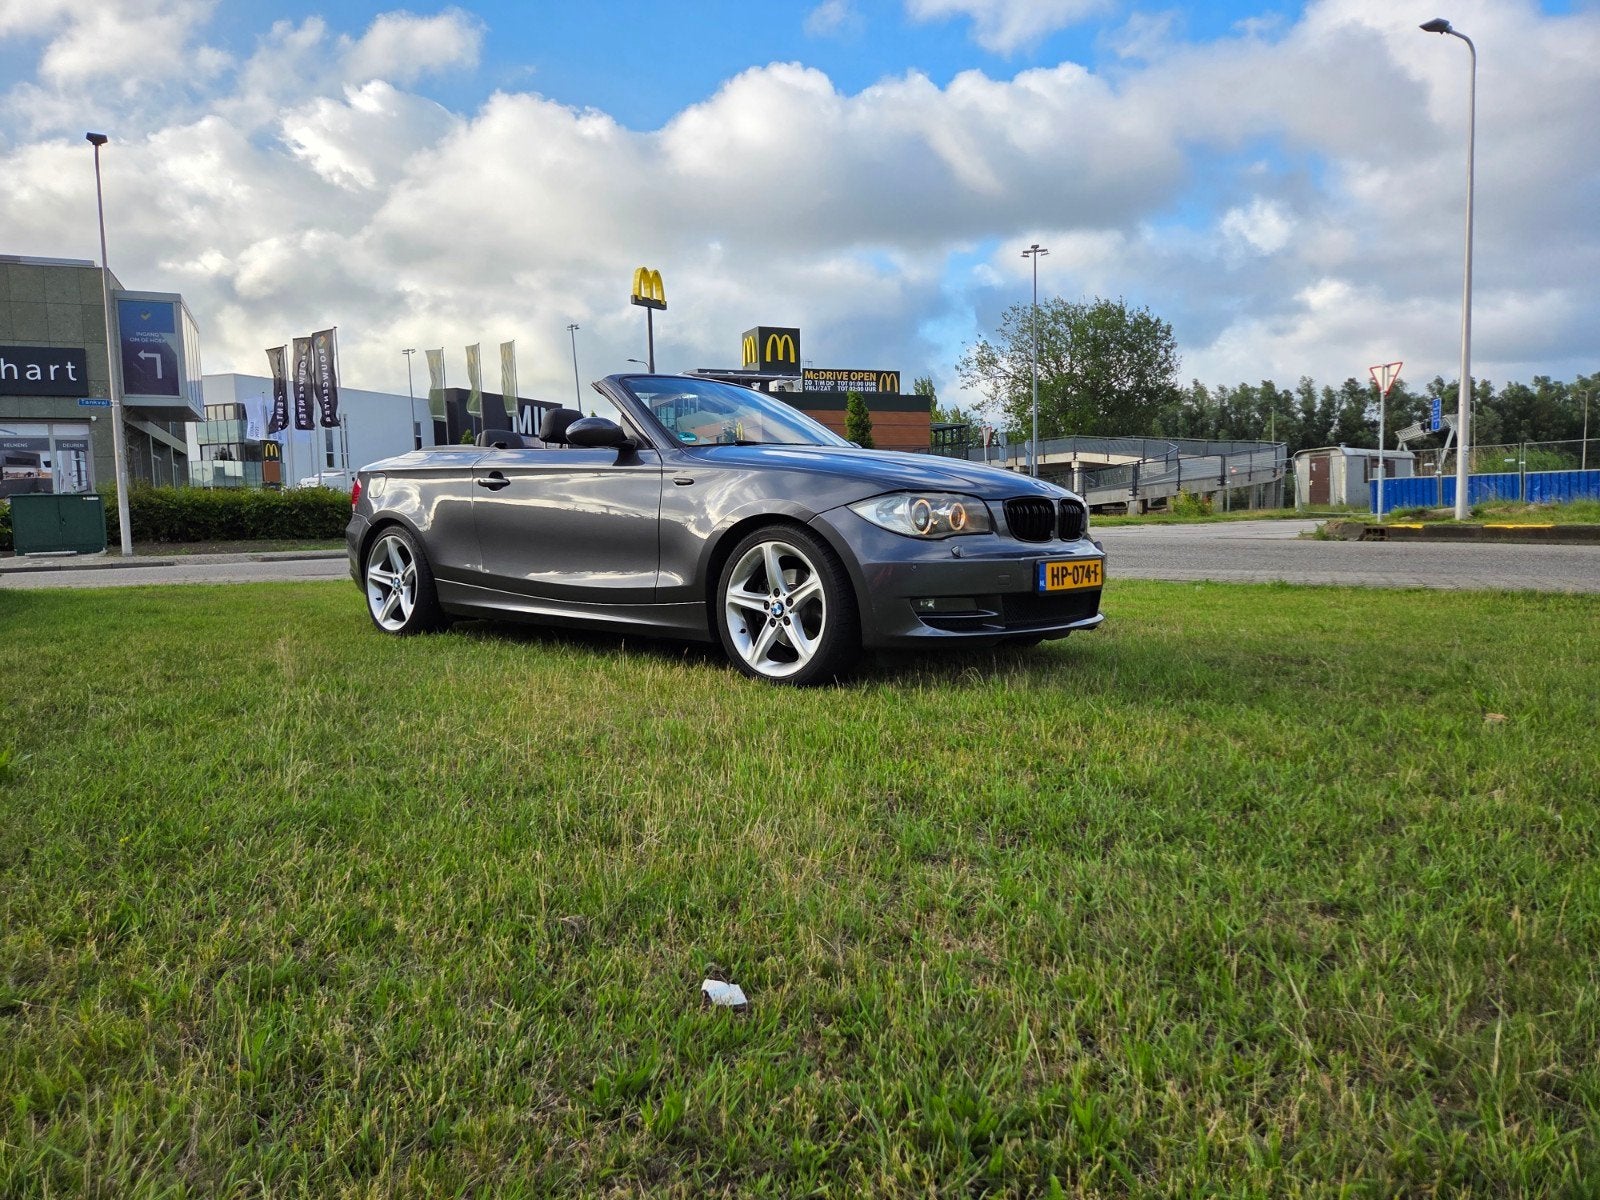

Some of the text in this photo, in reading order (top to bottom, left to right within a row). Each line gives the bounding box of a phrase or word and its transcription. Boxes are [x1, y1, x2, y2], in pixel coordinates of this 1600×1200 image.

[0, 358, 77, 381] hart
[804, 370, 849, 381] McDRIVE
[850, 371, 877, 381] OPEN
[1051, 564, 1099, 587] HP-074-F
